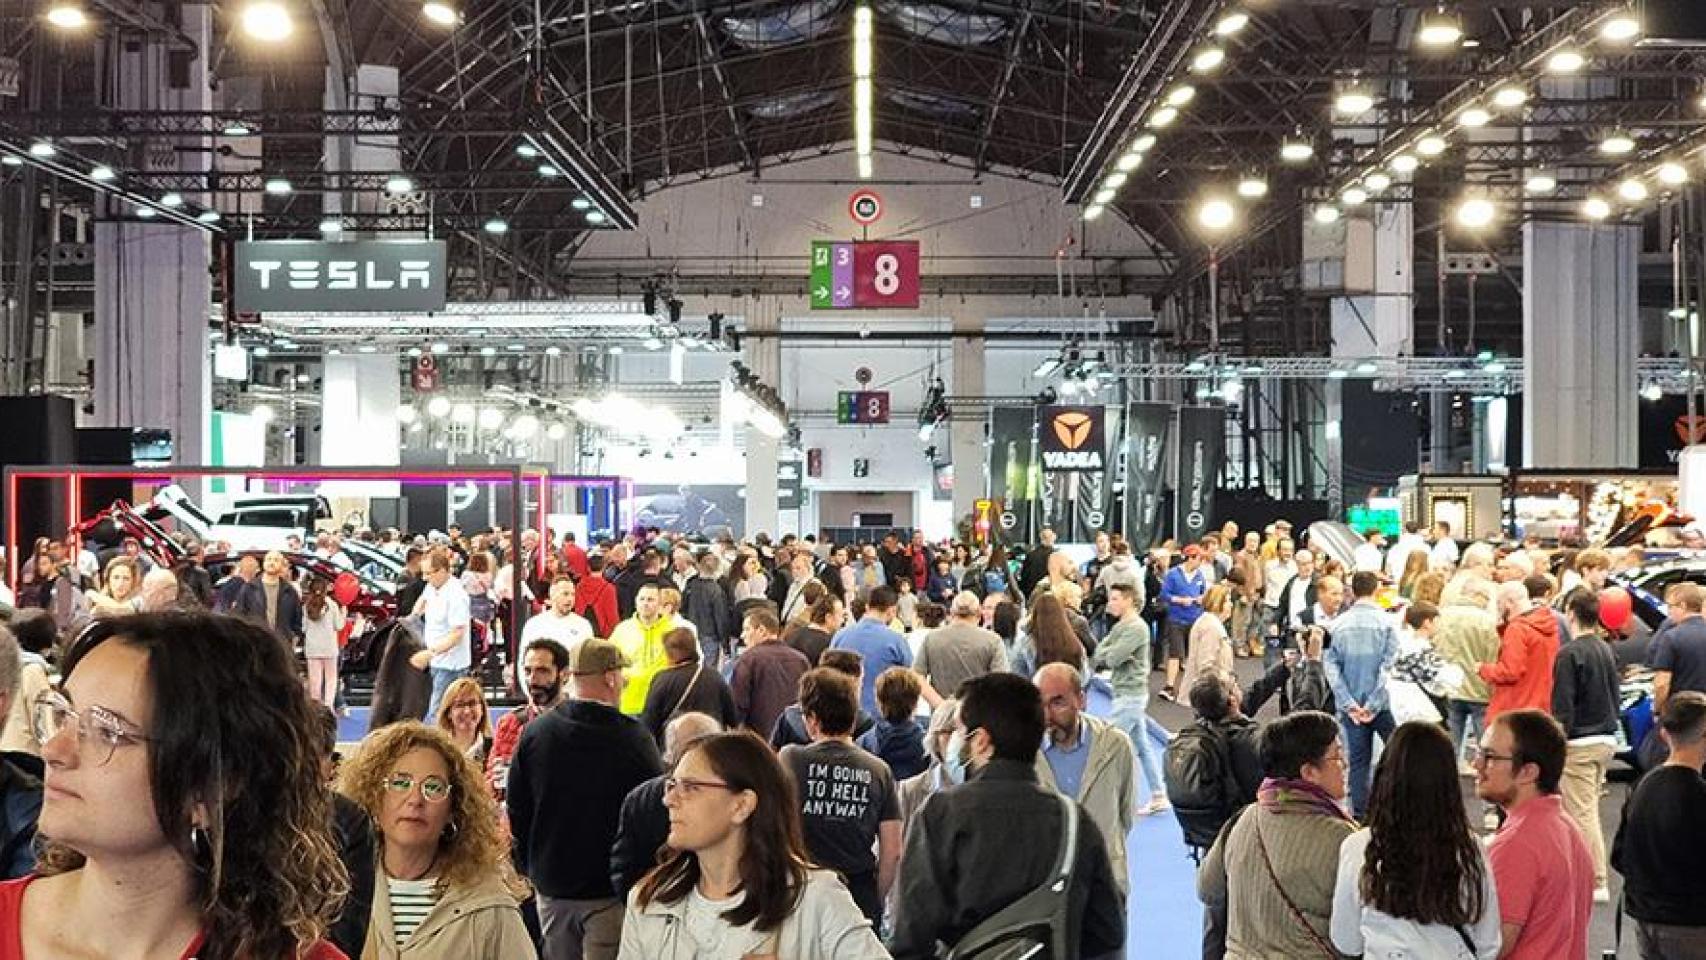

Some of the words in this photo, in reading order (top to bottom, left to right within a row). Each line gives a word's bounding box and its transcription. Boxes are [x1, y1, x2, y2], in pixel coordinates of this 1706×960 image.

[837, 248, 849, 266] 3
[249, 261, 430, 289] TESLA
[874, 253, 899, 295] 8
[868, 397, 880, 417] 8
[808, 763, 828, 778] I'M
[832, 765, 872, 783] GOING
[807, 781, 826, 798] TO
[831, 783, 870, 803] HELL
[803, 799, 867, 818] ANYWAY
